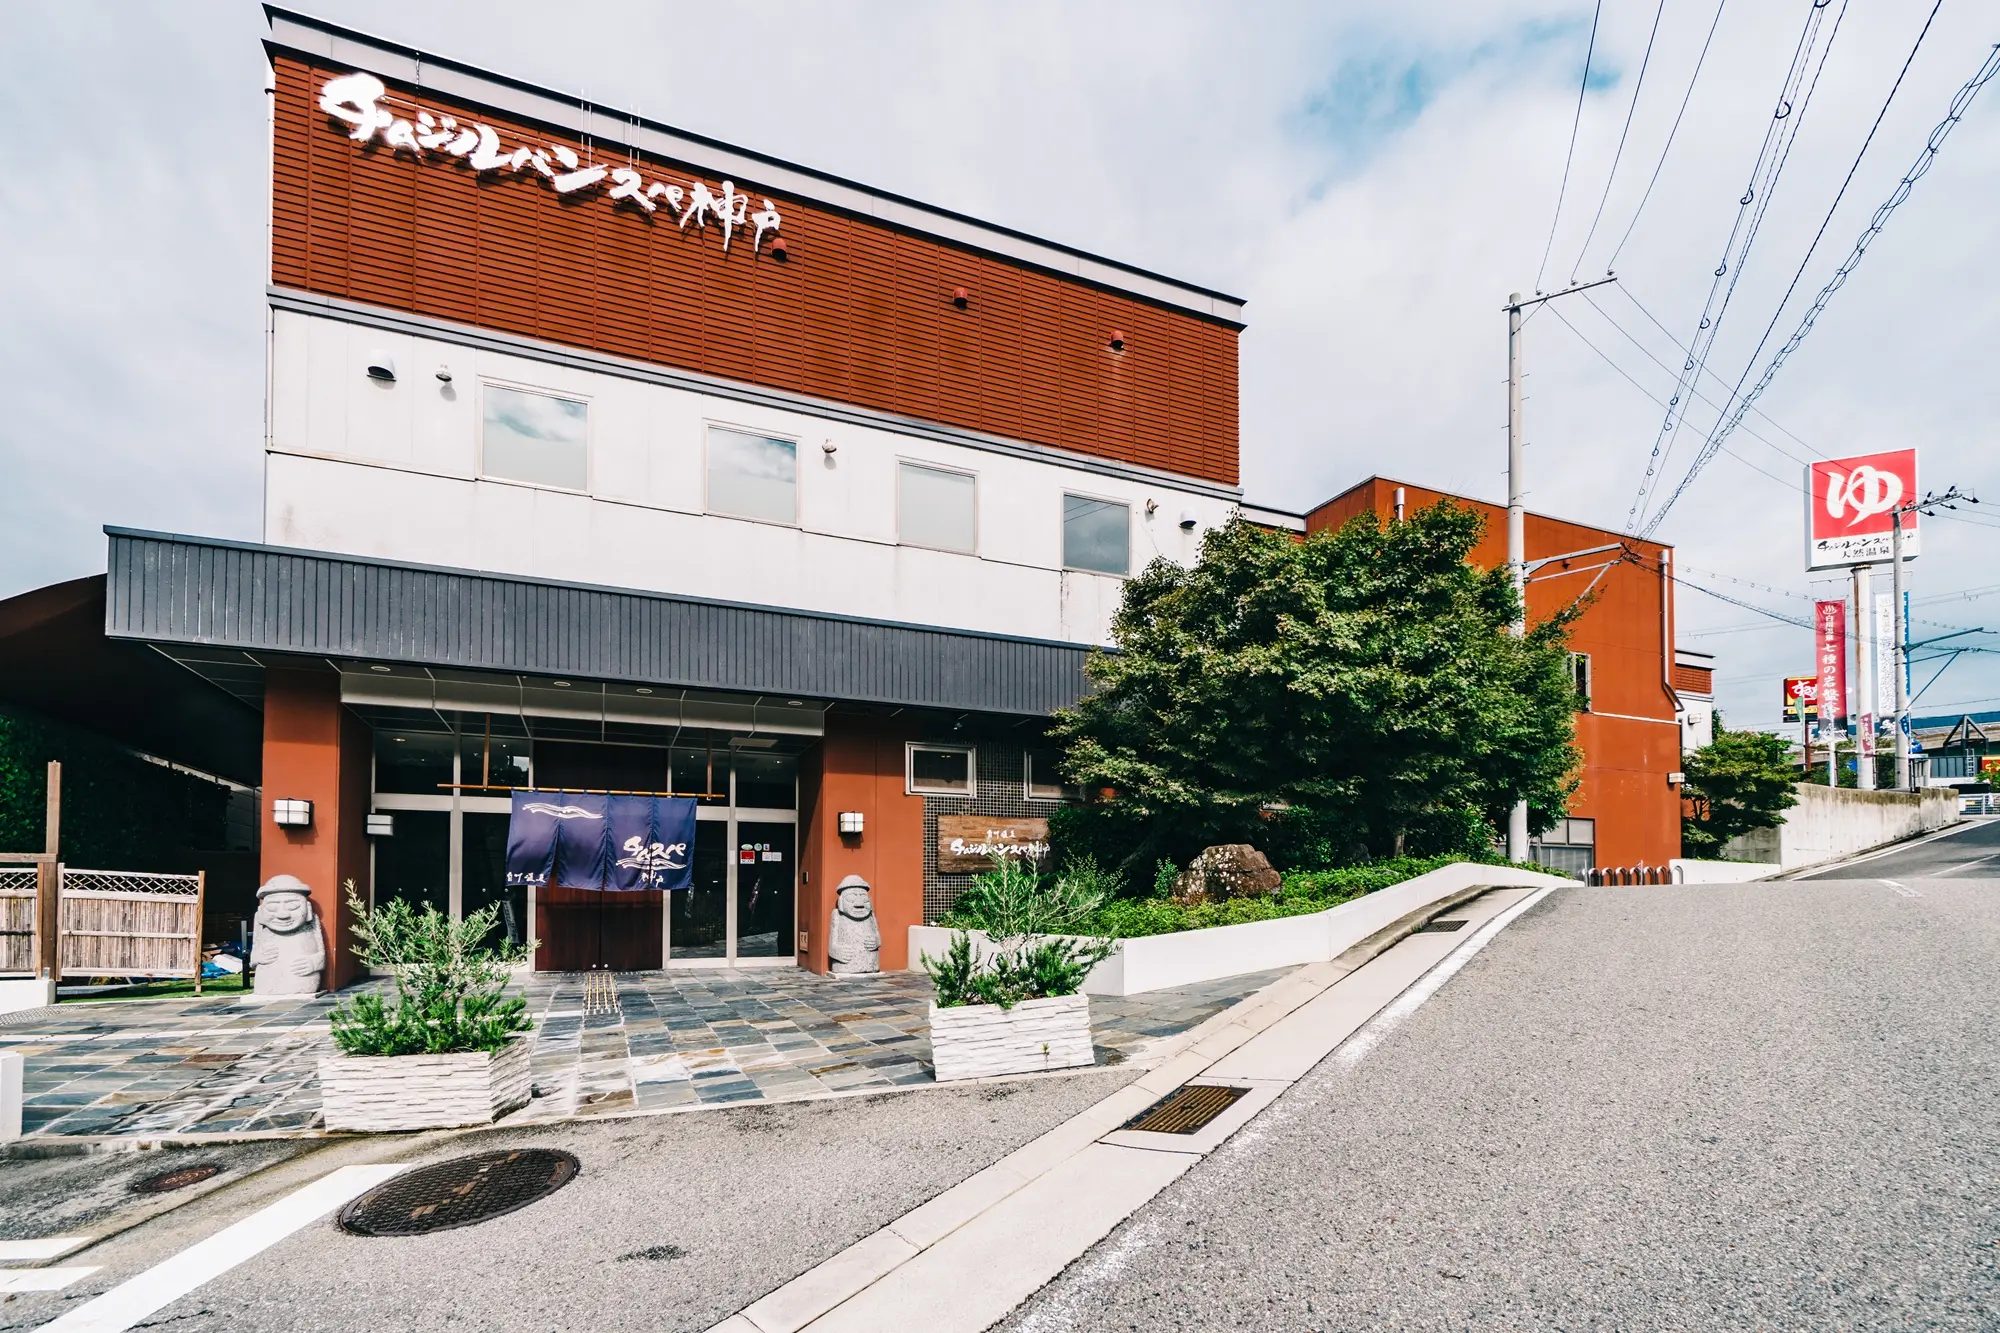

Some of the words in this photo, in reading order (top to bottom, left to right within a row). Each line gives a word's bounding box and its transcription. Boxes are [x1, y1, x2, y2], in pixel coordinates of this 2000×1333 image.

[319, 72, 781, 252] チムジルバンスパ神戸
[1825, 465, 1904, 528] ゆ
[1841, 546, 1891, 559] 天然温泉
